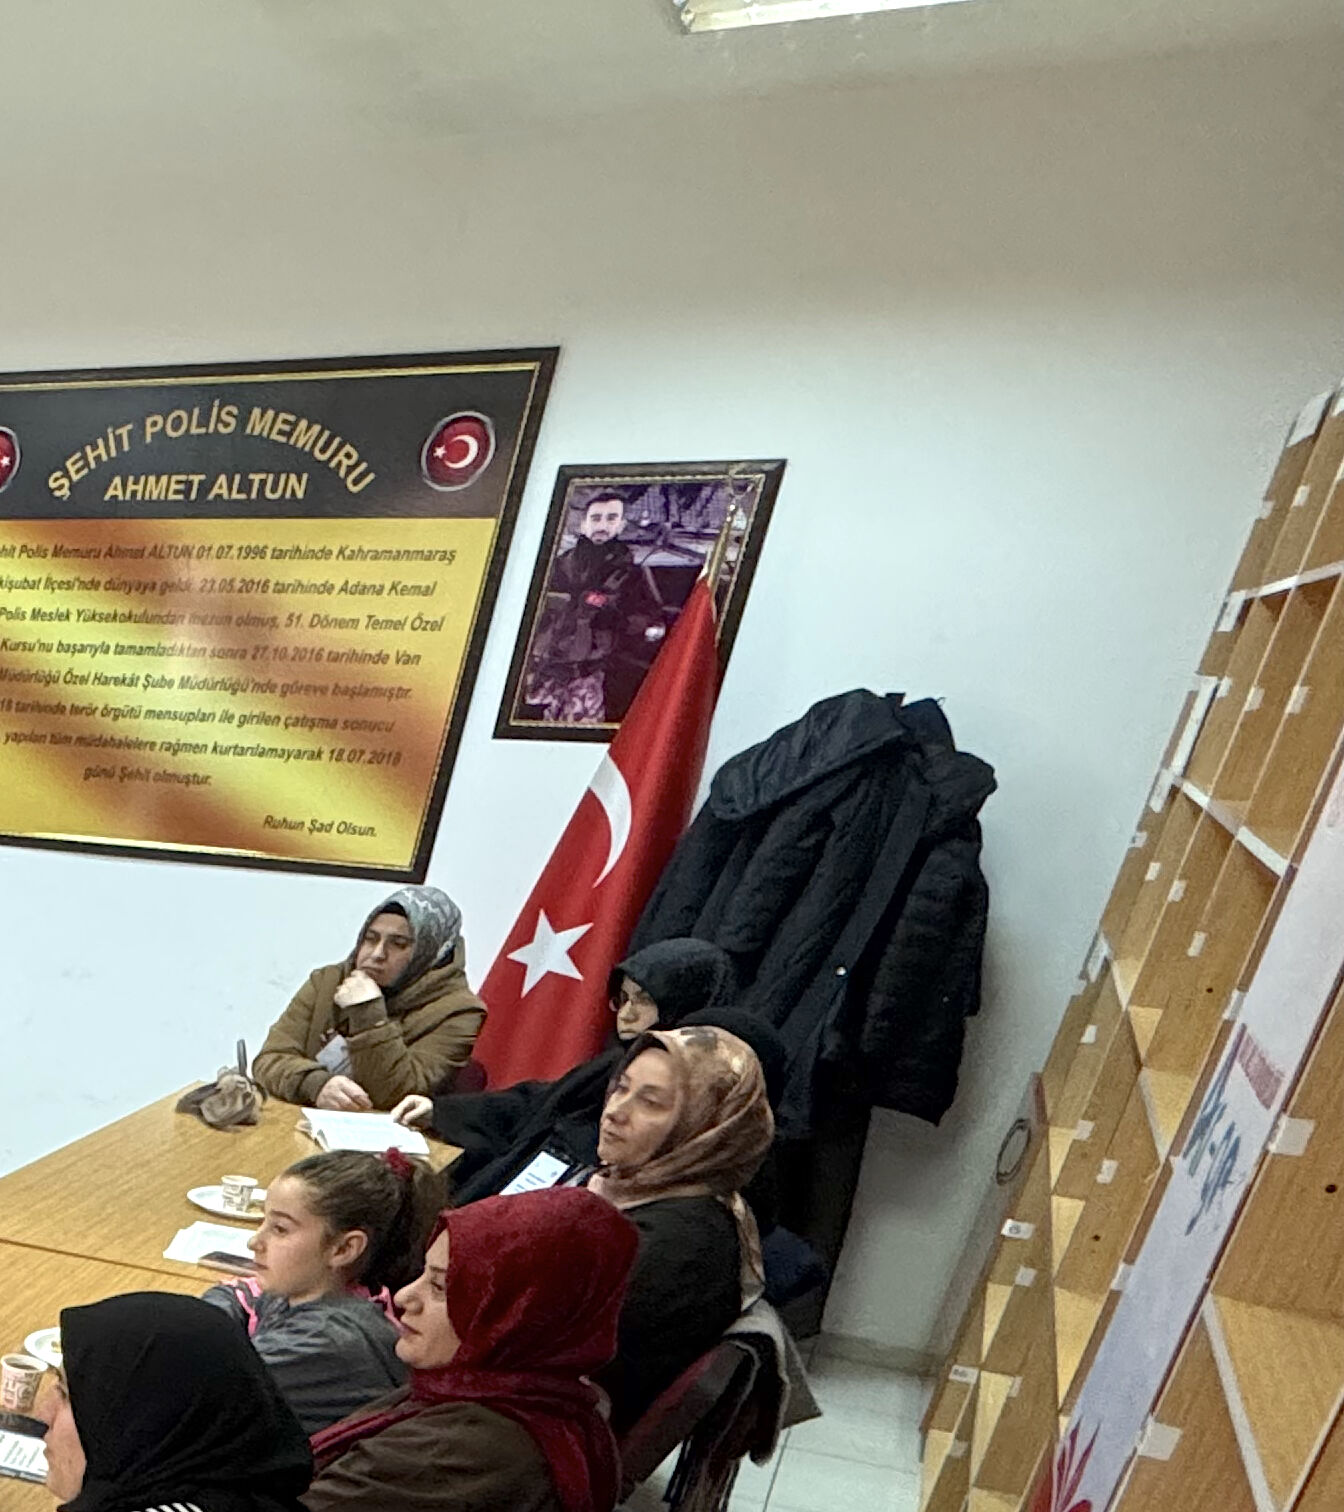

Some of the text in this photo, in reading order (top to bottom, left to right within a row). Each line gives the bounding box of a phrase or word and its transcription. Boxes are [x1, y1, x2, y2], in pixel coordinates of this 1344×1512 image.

[47, 399, 376, 500] ŞEHİT POLİS MEMURU
[104, 471, 308, 501] AHMET ALTUN
[17, 544, 48, 560] Polis
[147, 544, 194, 560] ALTUN
[270, 546, 332, 562] tarihinde
[335, 546, 456, 565] Kahramanmaraş
[272, 578, 335, 596] tarihinde
[337, 579, 384, 597] Adana
[387, 580, 437, 598] Kemal
[29, 607, 71, 623] Meslek
[308, 613, 360, 630] Dönem
[364, 614, 407, 631] Temel
[410, 612, 446, 632] Özel
[326, 648, 389, 665] tarihinde
[394, 649, 422, 666] Van
[63, 667, 90, 686] Özel
[142, 672, 175, 691] Şube
[218, 707, 236, 724] ile
[238, 709, 281, 728] girilen
[159, 740, 208, 757] rağmen
[263, 814, 378, 838] Ruhun Şad Olsun.
